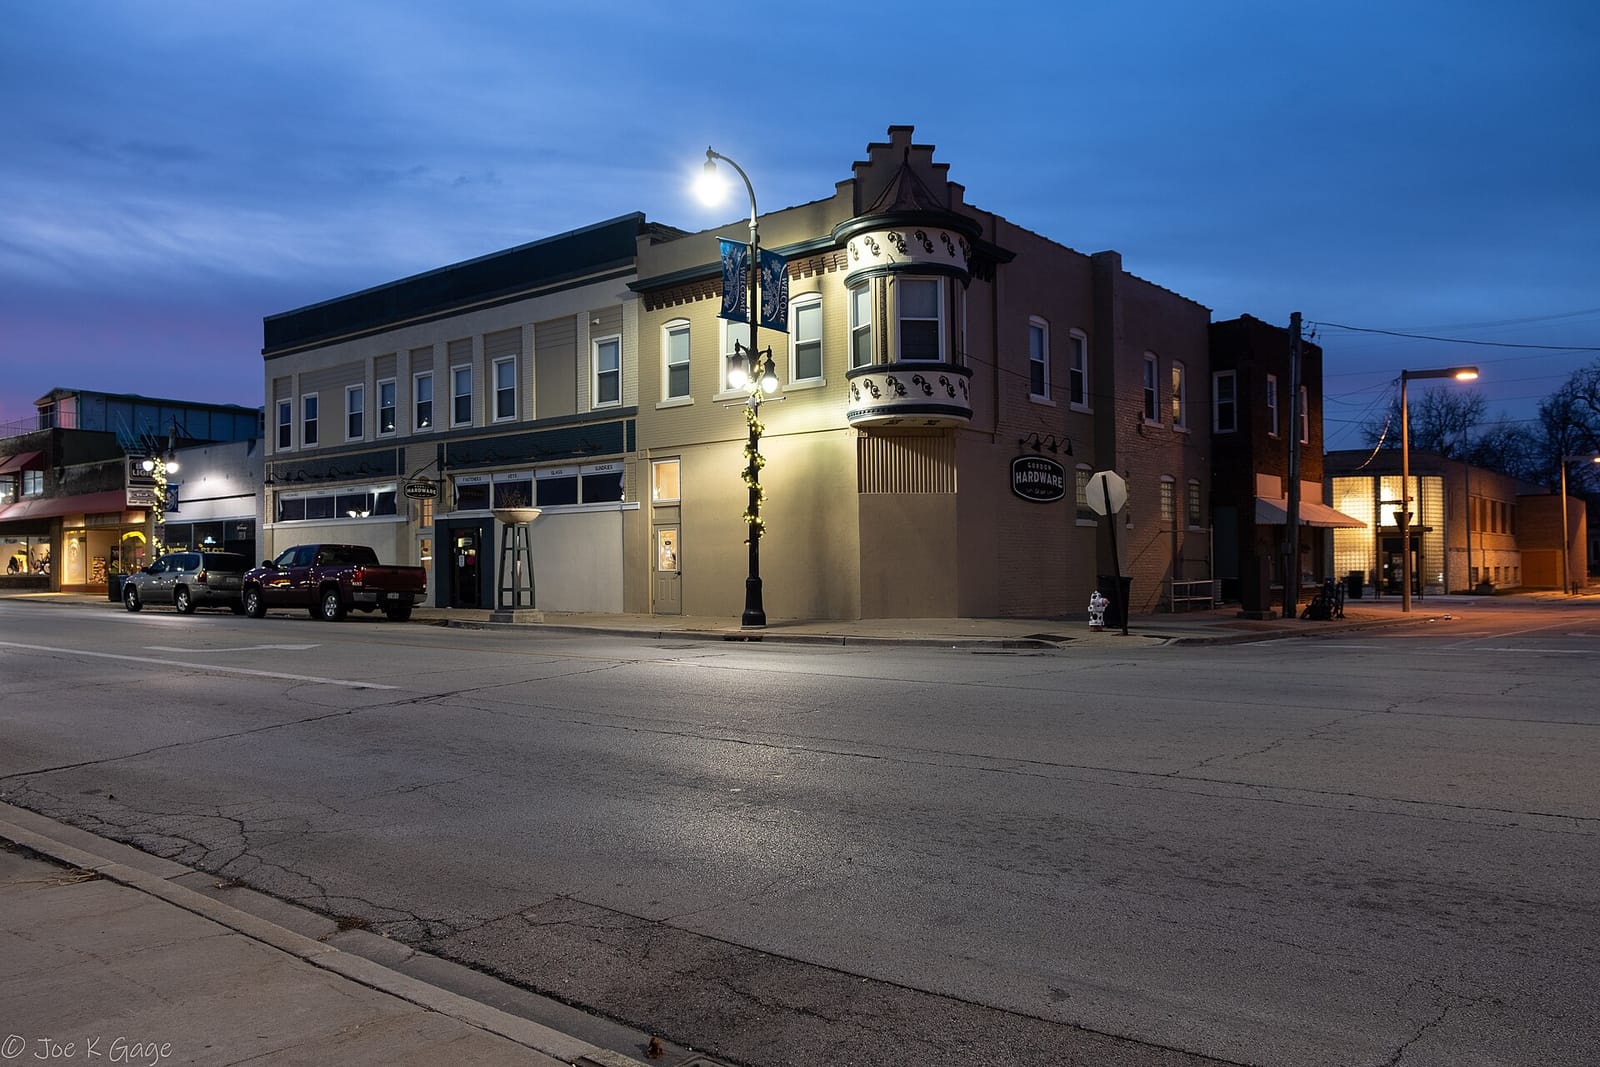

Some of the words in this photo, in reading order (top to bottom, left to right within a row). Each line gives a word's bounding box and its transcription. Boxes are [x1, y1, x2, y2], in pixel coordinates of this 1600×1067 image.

[779, 277, 788, 322] WELCOME
[132, 469, 153, 477] LIGH
[1015, 470, 1063, 489] HARDWARE
